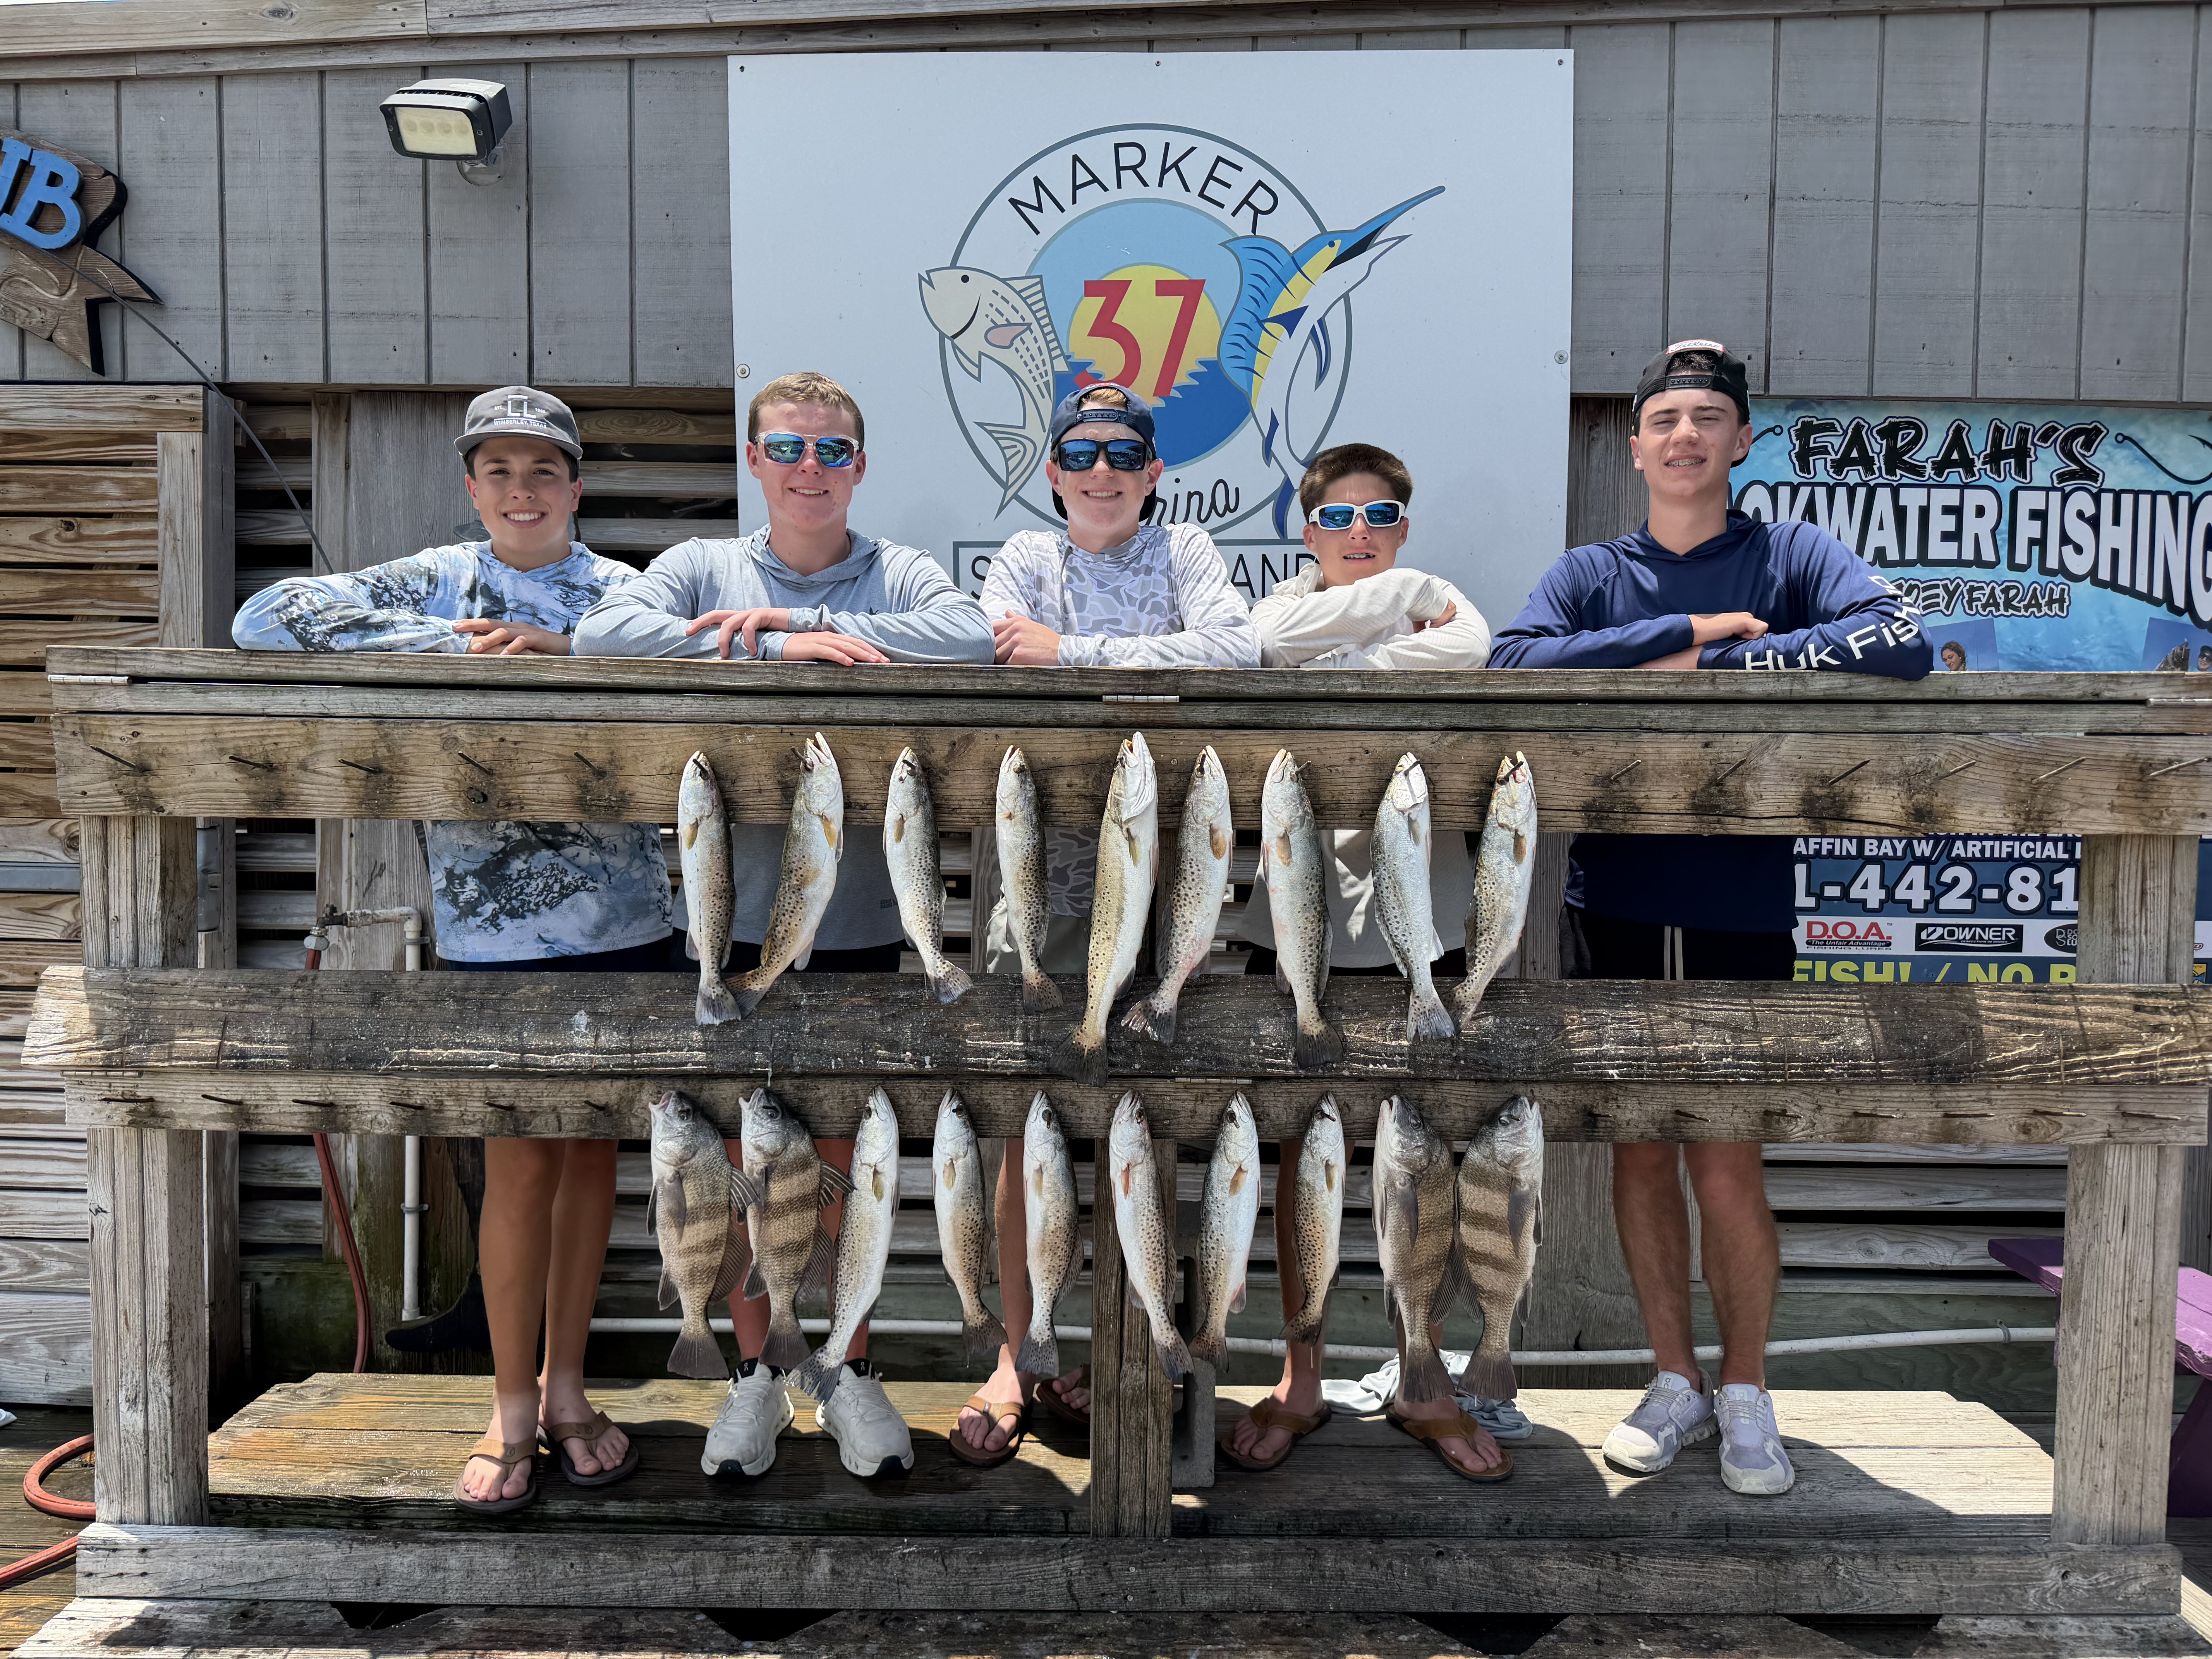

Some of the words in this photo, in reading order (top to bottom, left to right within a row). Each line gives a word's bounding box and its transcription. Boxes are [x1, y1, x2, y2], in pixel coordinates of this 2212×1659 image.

[1008, 141, 1279, 235] MARKER
[1072, 279, 1206, 397] 37
[1791, 417, 2108, 487] FARAH'S
[1145, 478, 1239, 527] rina
[2016, 490, 2212, 622] FISHING
[1965, 582, 2070, 616] FARAH
[1745, 643, 1841, 670] Huk
[1793, 838, 1857, 855] AFFIN
[1864, 838, 1908, 856] BAY
[1951, 840, 2069, 859] ARTIFICIAL
[1806, 921, 1892, 940] D.O.A.
[1944, 927, 2016, 941] OWNER
